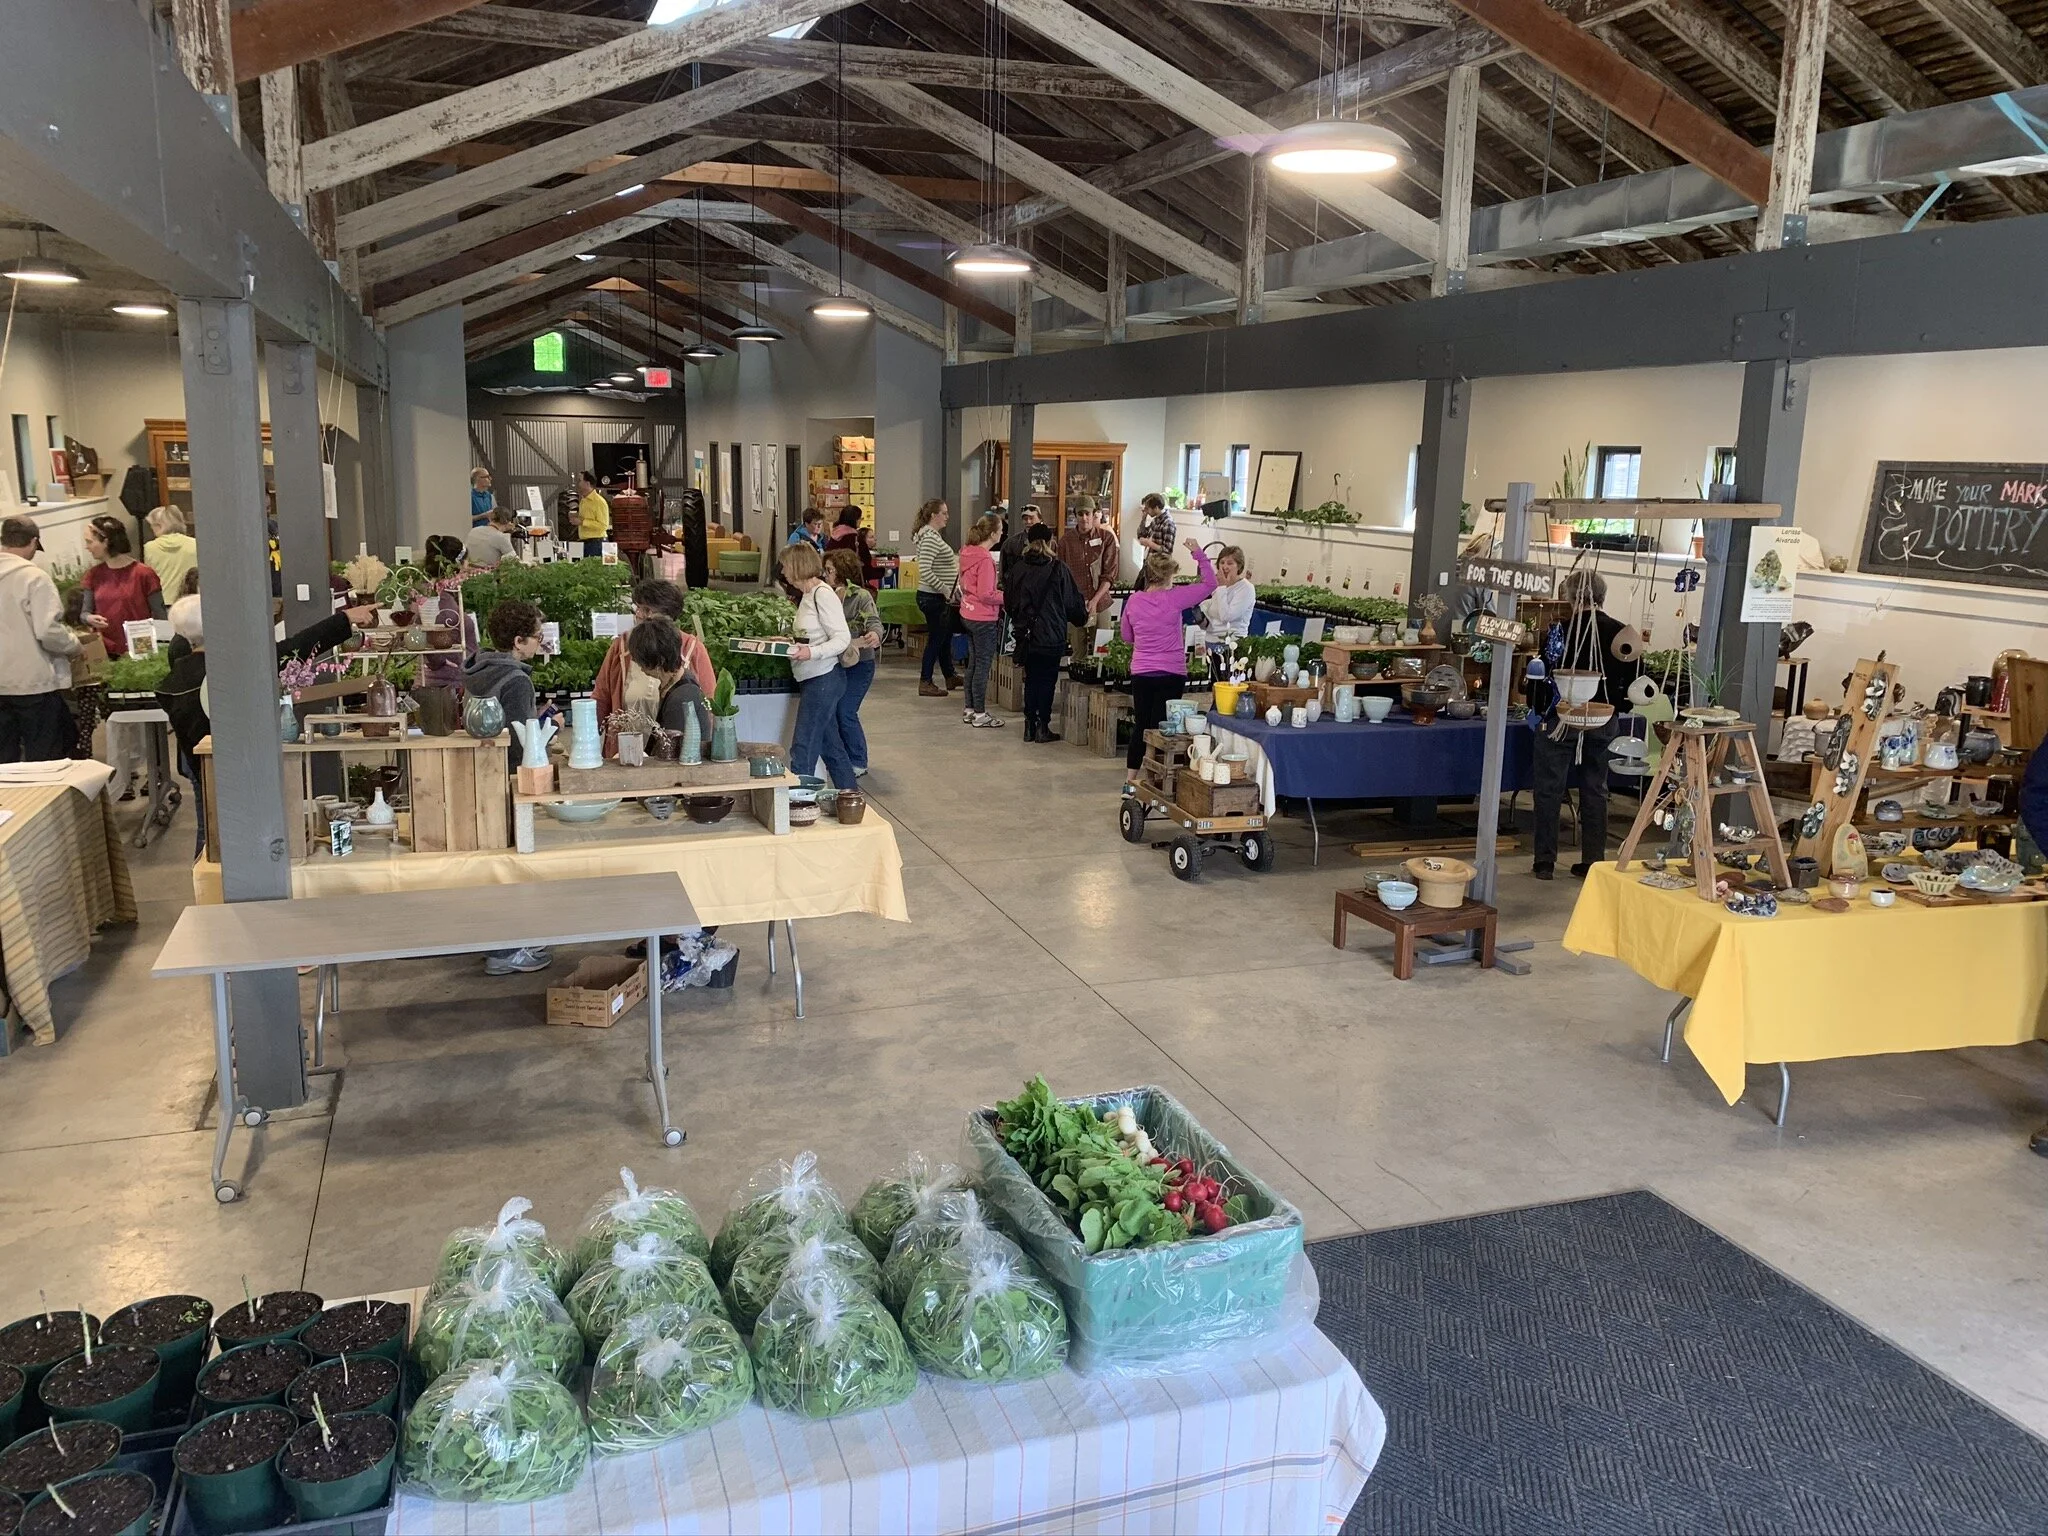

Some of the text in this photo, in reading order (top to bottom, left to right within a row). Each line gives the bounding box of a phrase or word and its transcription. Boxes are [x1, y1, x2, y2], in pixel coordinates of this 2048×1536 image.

[1908, 476, 2048, 508] MAKE YOUR MARK
[1924, 504, 2048, 555] POTTERY
[1467, 564, 1551, 593] FOR THE BIRDS
[1480, 616, 1522, 635] BLOWIN' IN
[1480, 626, 1517, 641] THE WIND
